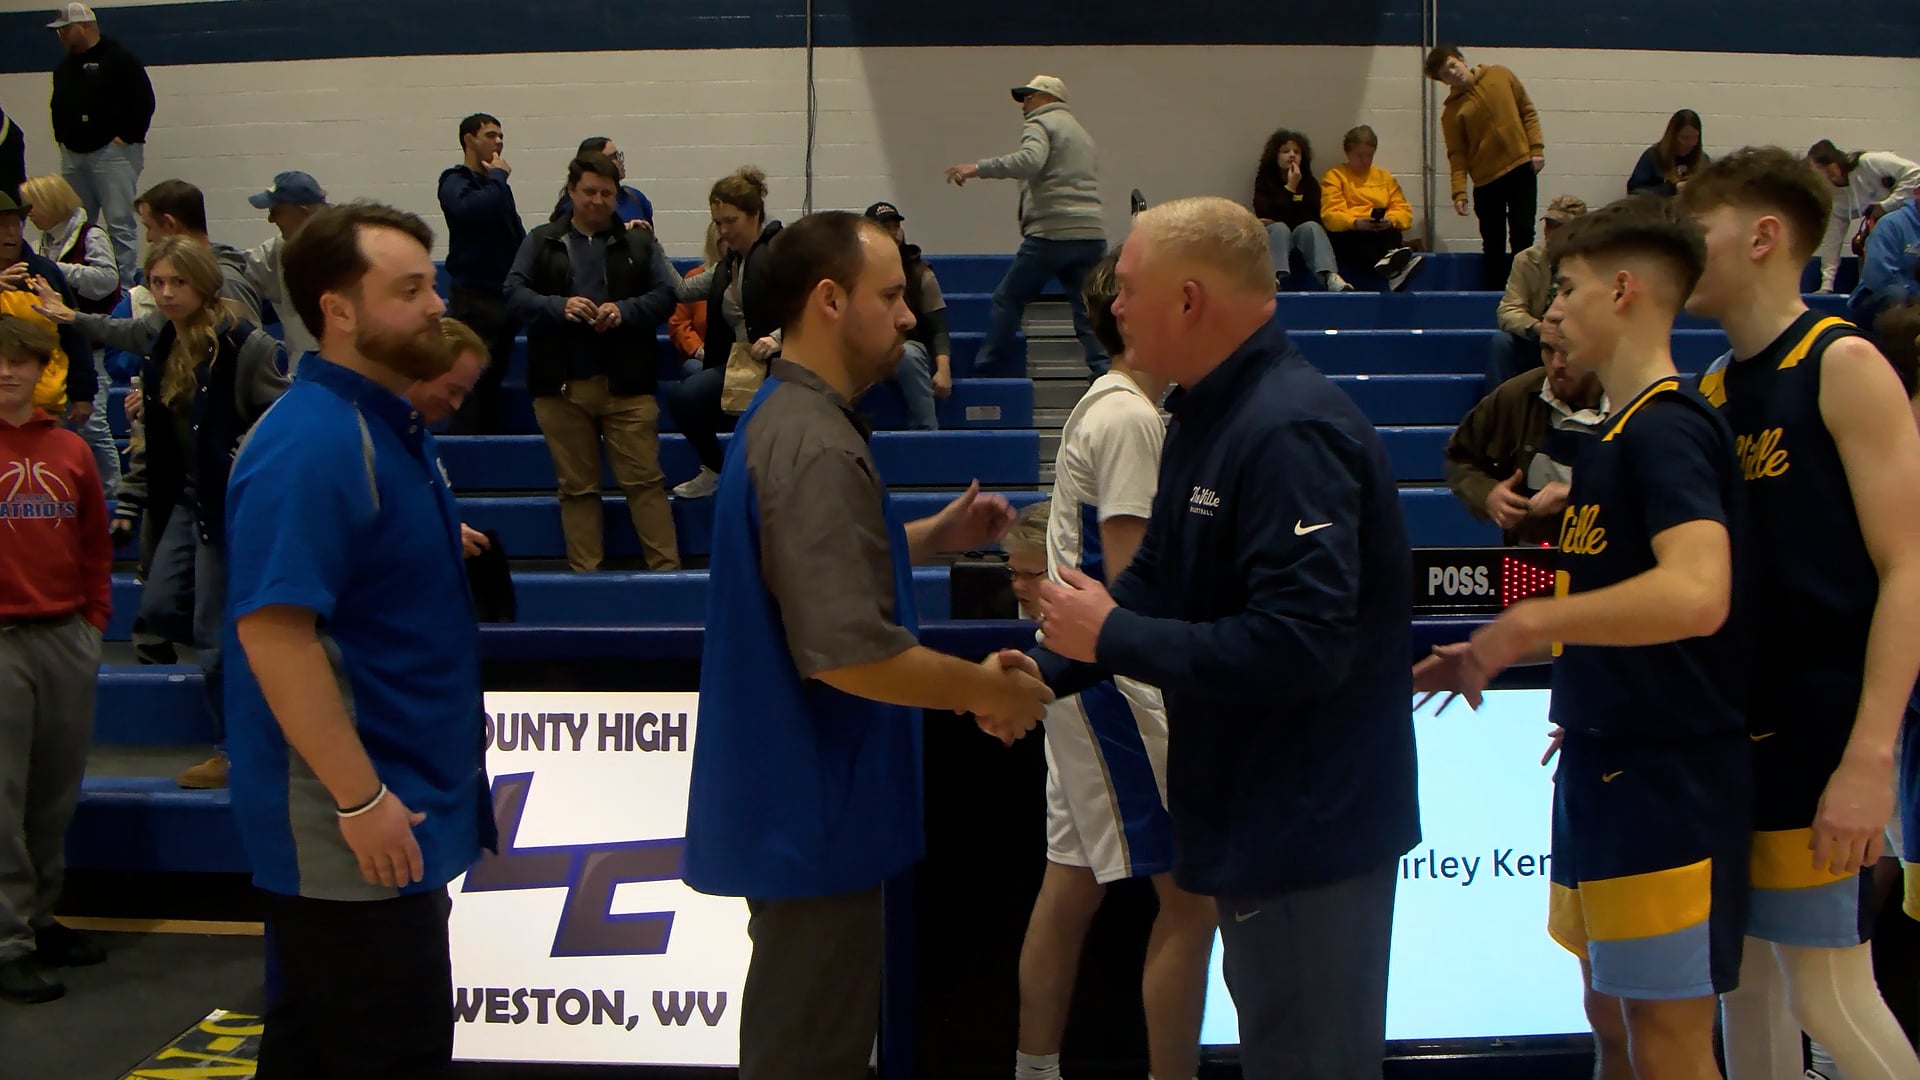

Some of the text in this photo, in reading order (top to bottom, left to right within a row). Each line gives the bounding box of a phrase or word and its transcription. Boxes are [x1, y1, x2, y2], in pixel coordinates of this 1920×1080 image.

[1198, 488, 1220, 507] Ville
[1428, 566, 1495, 596] POSS.
[598, 712, 688, 752] HIGH
[453, 987, 727, 1032] WESTON, WV
